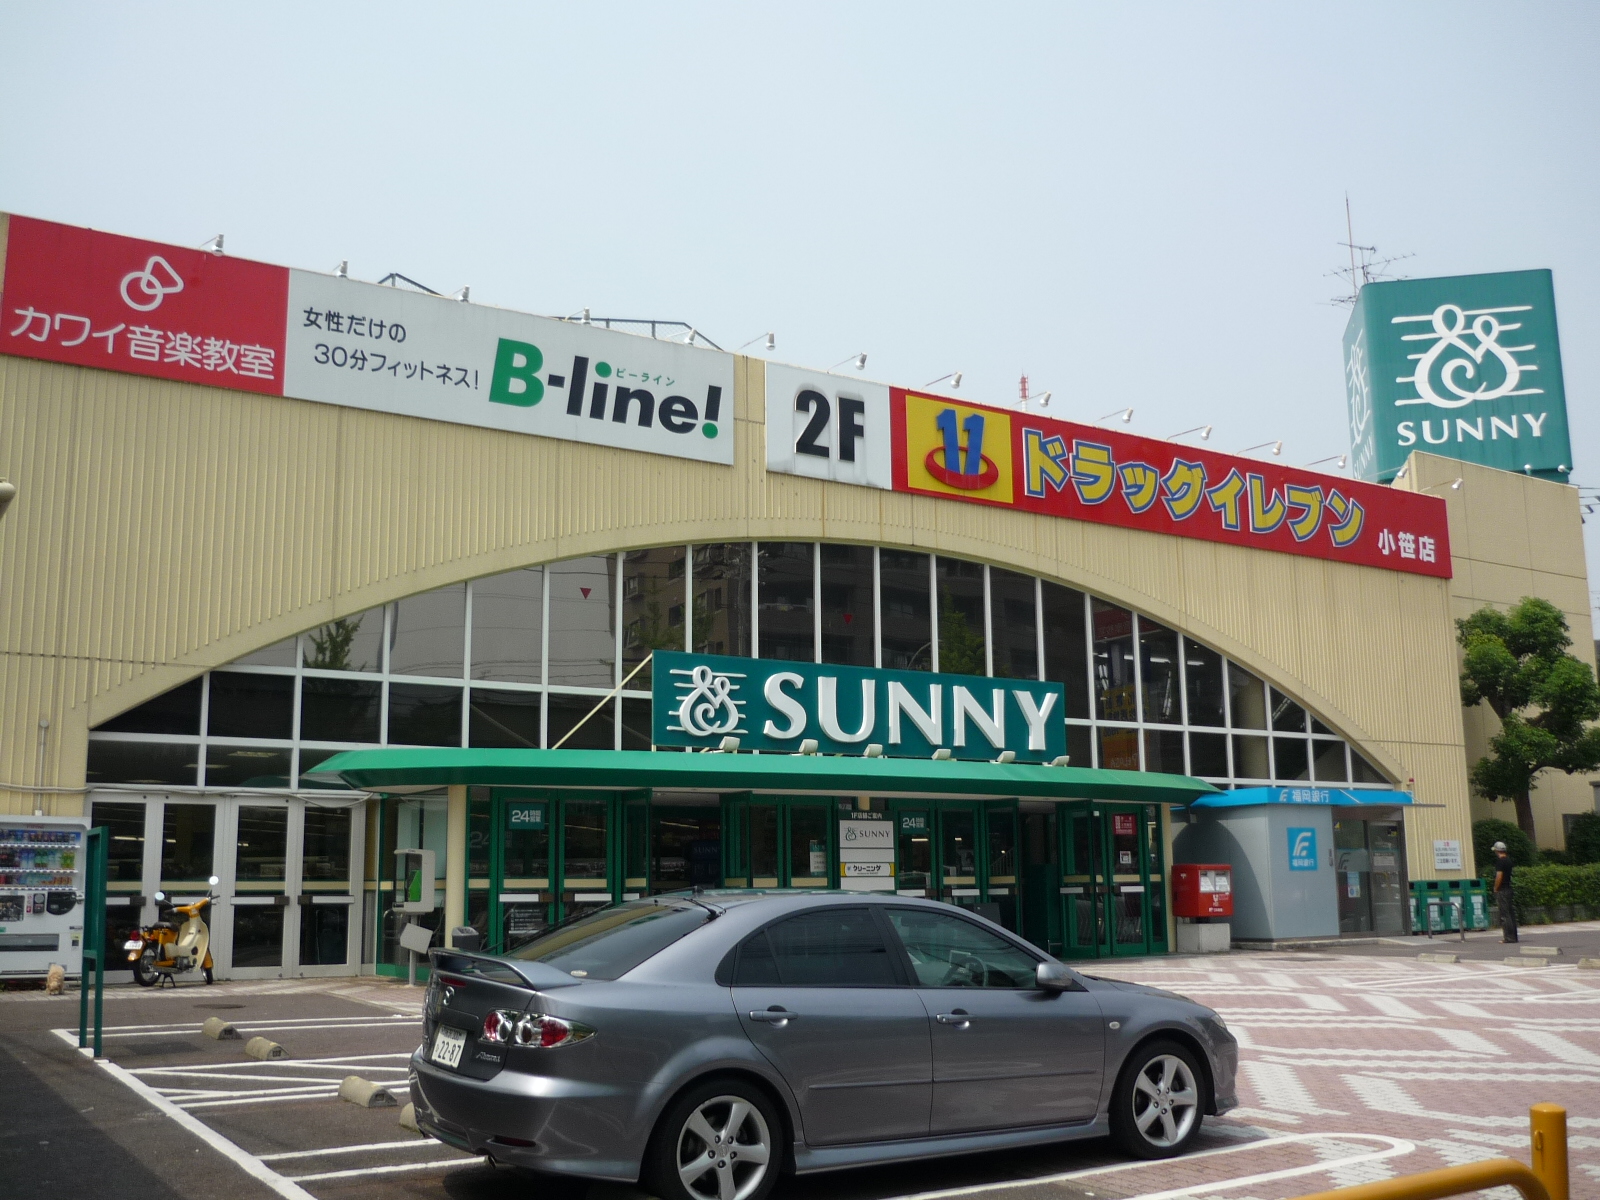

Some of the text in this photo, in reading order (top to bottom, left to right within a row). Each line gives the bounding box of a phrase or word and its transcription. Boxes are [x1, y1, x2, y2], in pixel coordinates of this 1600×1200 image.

[11, 305, 275, 380] カワイ音楽教室
[303, 306, 407, 343] 女性だけの
[489, 337, 722, 439] B-line!
[616, 368, 676, 387] ビーライン
[794, 388, 865, 462] 2F
[1397, 412, 1547, 446] SUNNY
[1353, 432, 1374, 480] SUNNY
[1022, 427, 1364, 548] ドラッグイレブン
[1377, 528, 1436, 563] 小笹店
[762, 671, 1059, 751] SUNNY
[1292, 789, 1330, 803] 福岡銀行
[859, 830, 890, 838] SUNNY
[853, 864, 881, 872] クリーニング
